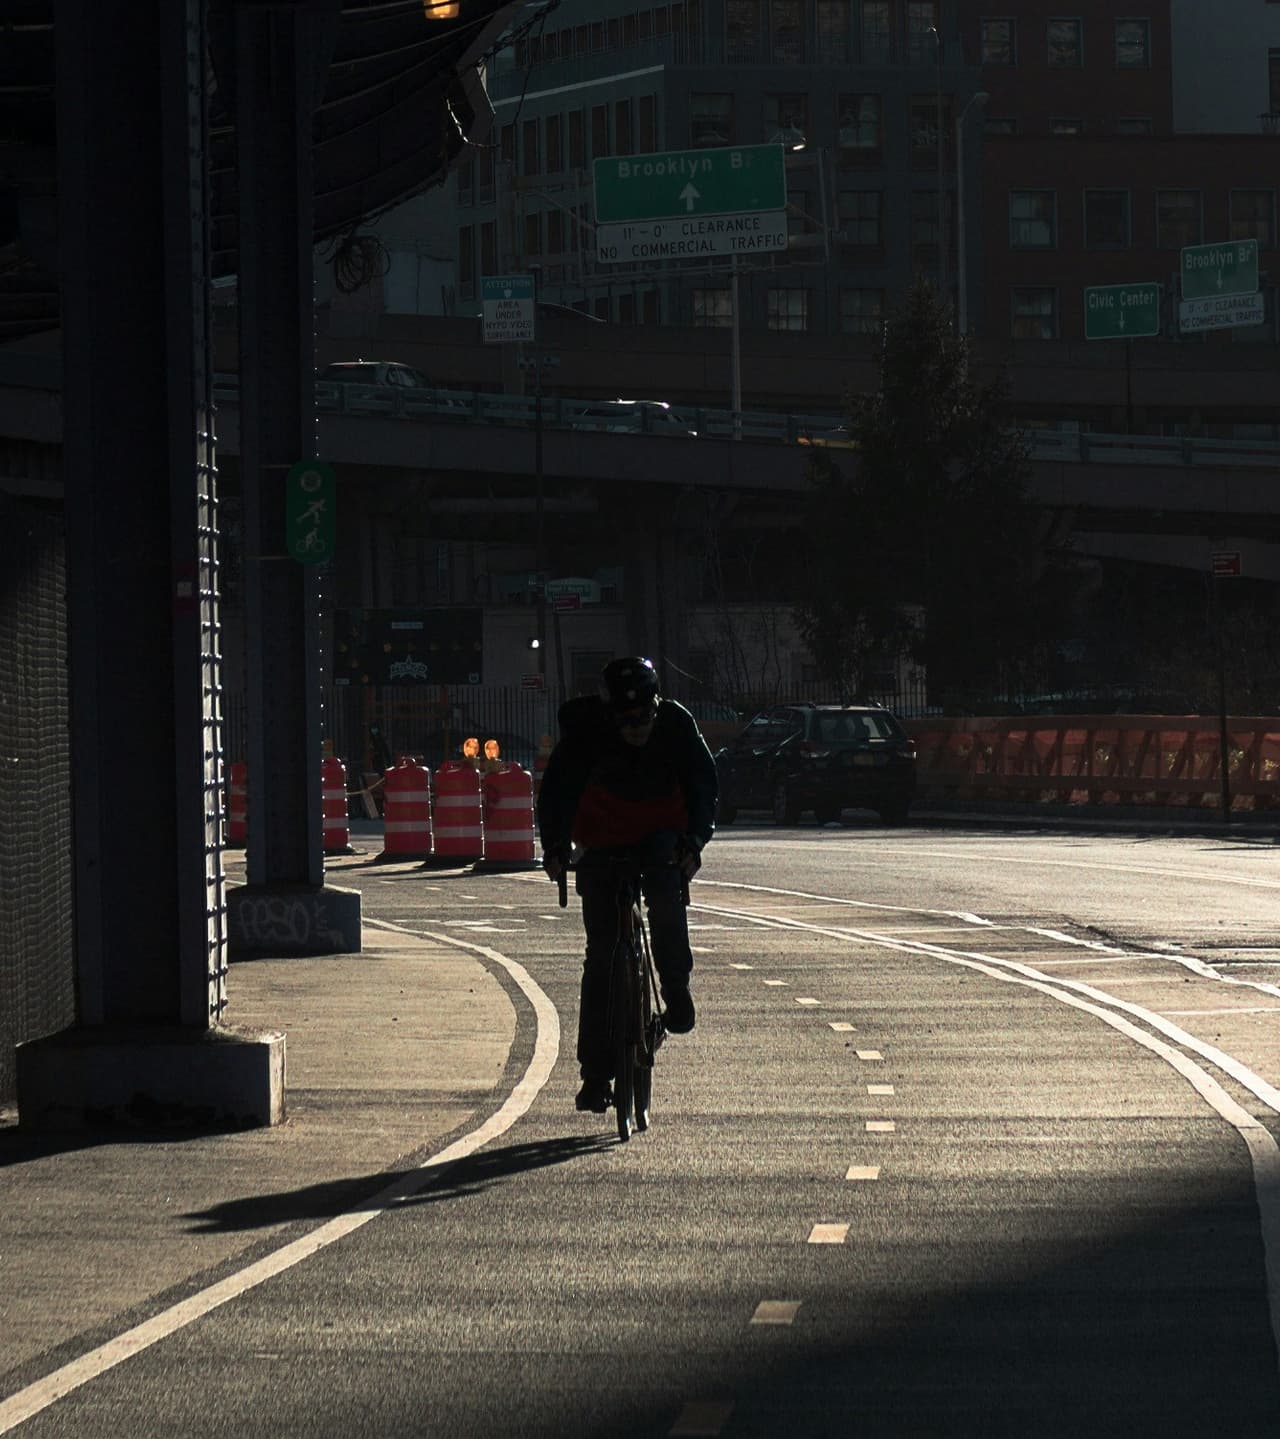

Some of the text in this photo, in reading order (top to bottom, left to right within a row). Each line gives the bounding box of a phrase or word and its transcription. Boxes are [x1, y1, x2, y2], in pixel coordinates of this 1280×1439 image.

[618, 158, 713, 179] Brooklyn
[682, 218, 761, 236] CLEARANCE
[599, 232, 785, 259] NO COMMERCIAL TRAFFIC
[1184, 250, 1233, 270] Brooklyn
[1088, 290, 1155, 309] Civic Center
